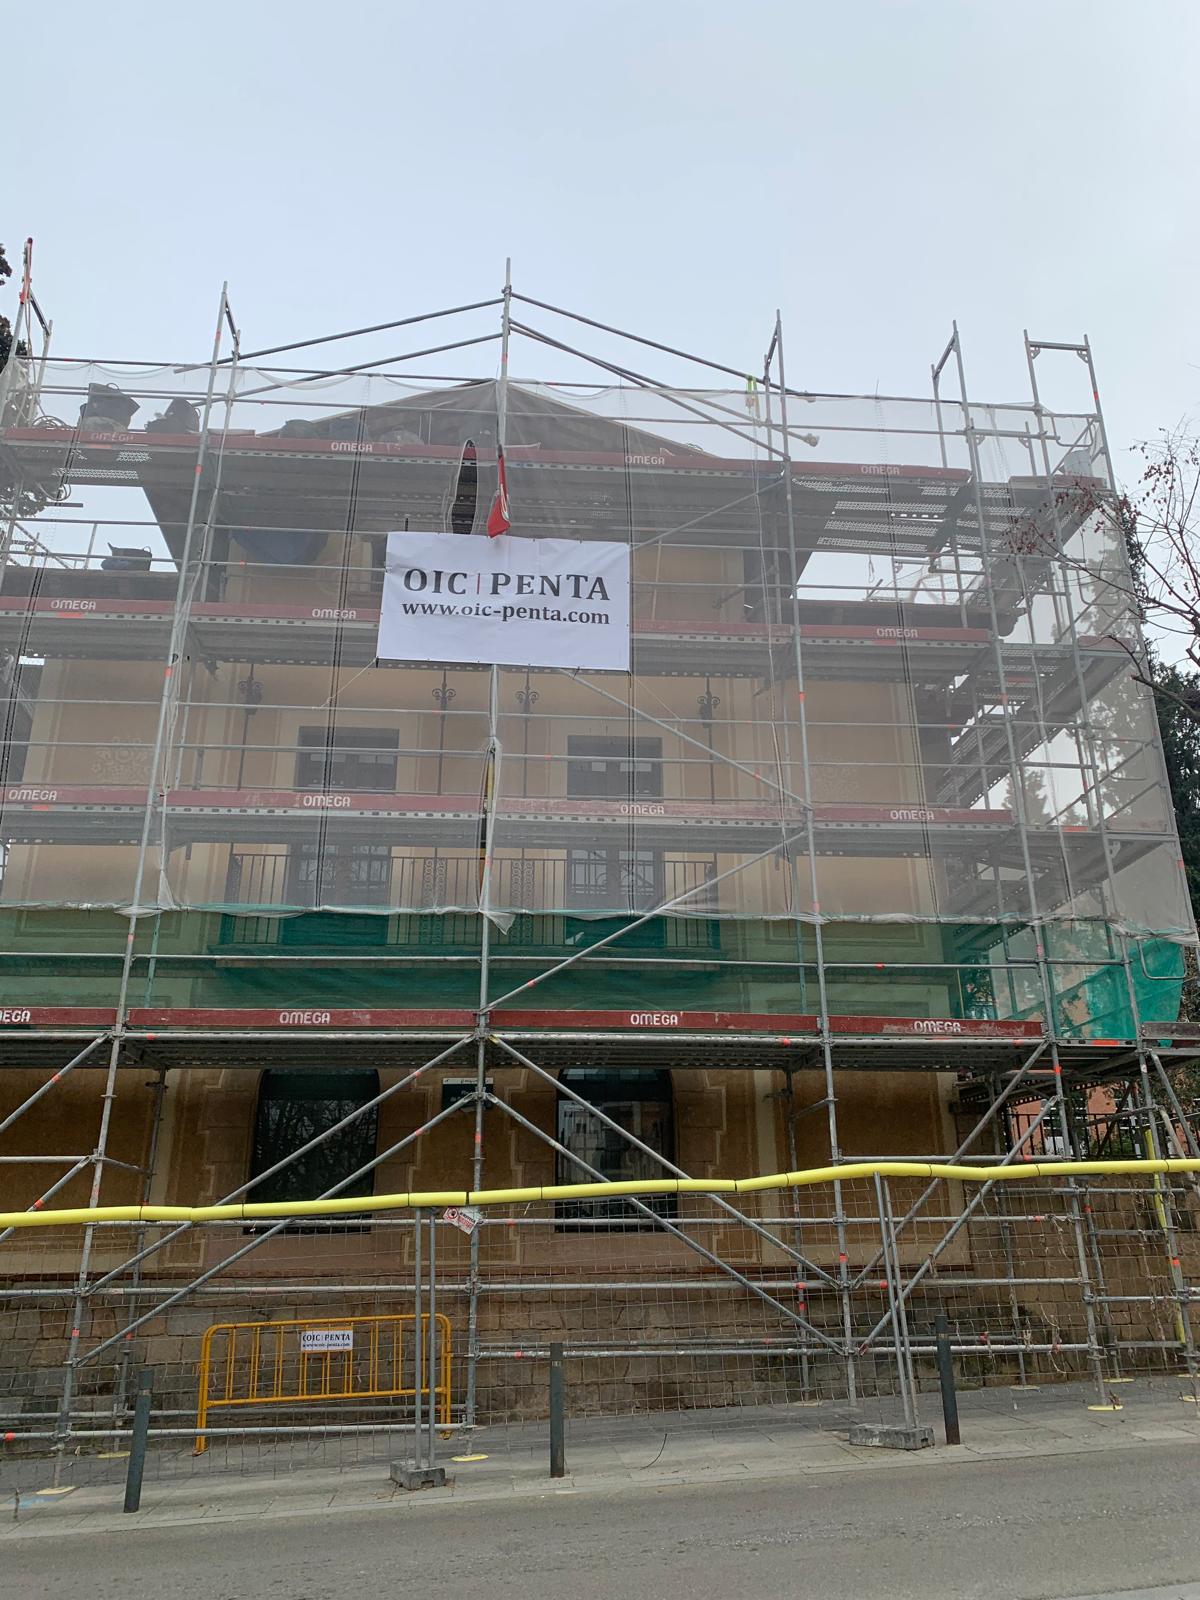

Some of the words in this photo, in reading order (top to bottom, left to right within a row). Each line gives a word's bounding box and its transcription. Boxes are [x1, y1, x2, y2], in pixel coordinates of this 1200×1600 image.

[331, 441, 373, 453] OMEGA
[625, 454, 665, 465] OMEGA
[861, 464, 901, 475] OMEGA
[403, 568, 468, 595] OIC
[490, 572, 610, 601] PENTA
[50, 598, 97, 610] OMEGA
[311, 608, 357, 620] OMEGA
[402, 603, 610, 625] www.oic-penta.com
[876, 627, 919, 639] OMEGA
[8, 789, 58, 801] OMEGA
[303, 794, 351, 807] OMEGA
[620, 803, 665, 815] OMEGA
[890, 809, 935, 821] OMEGA
[0, 1010, 31, 1023] EGA
[279, 1011, 331, 1024] OMEGA
[630, 1013, 679, 1026] OMEGA
[913, 1020, 962, 1032] OMEGA
